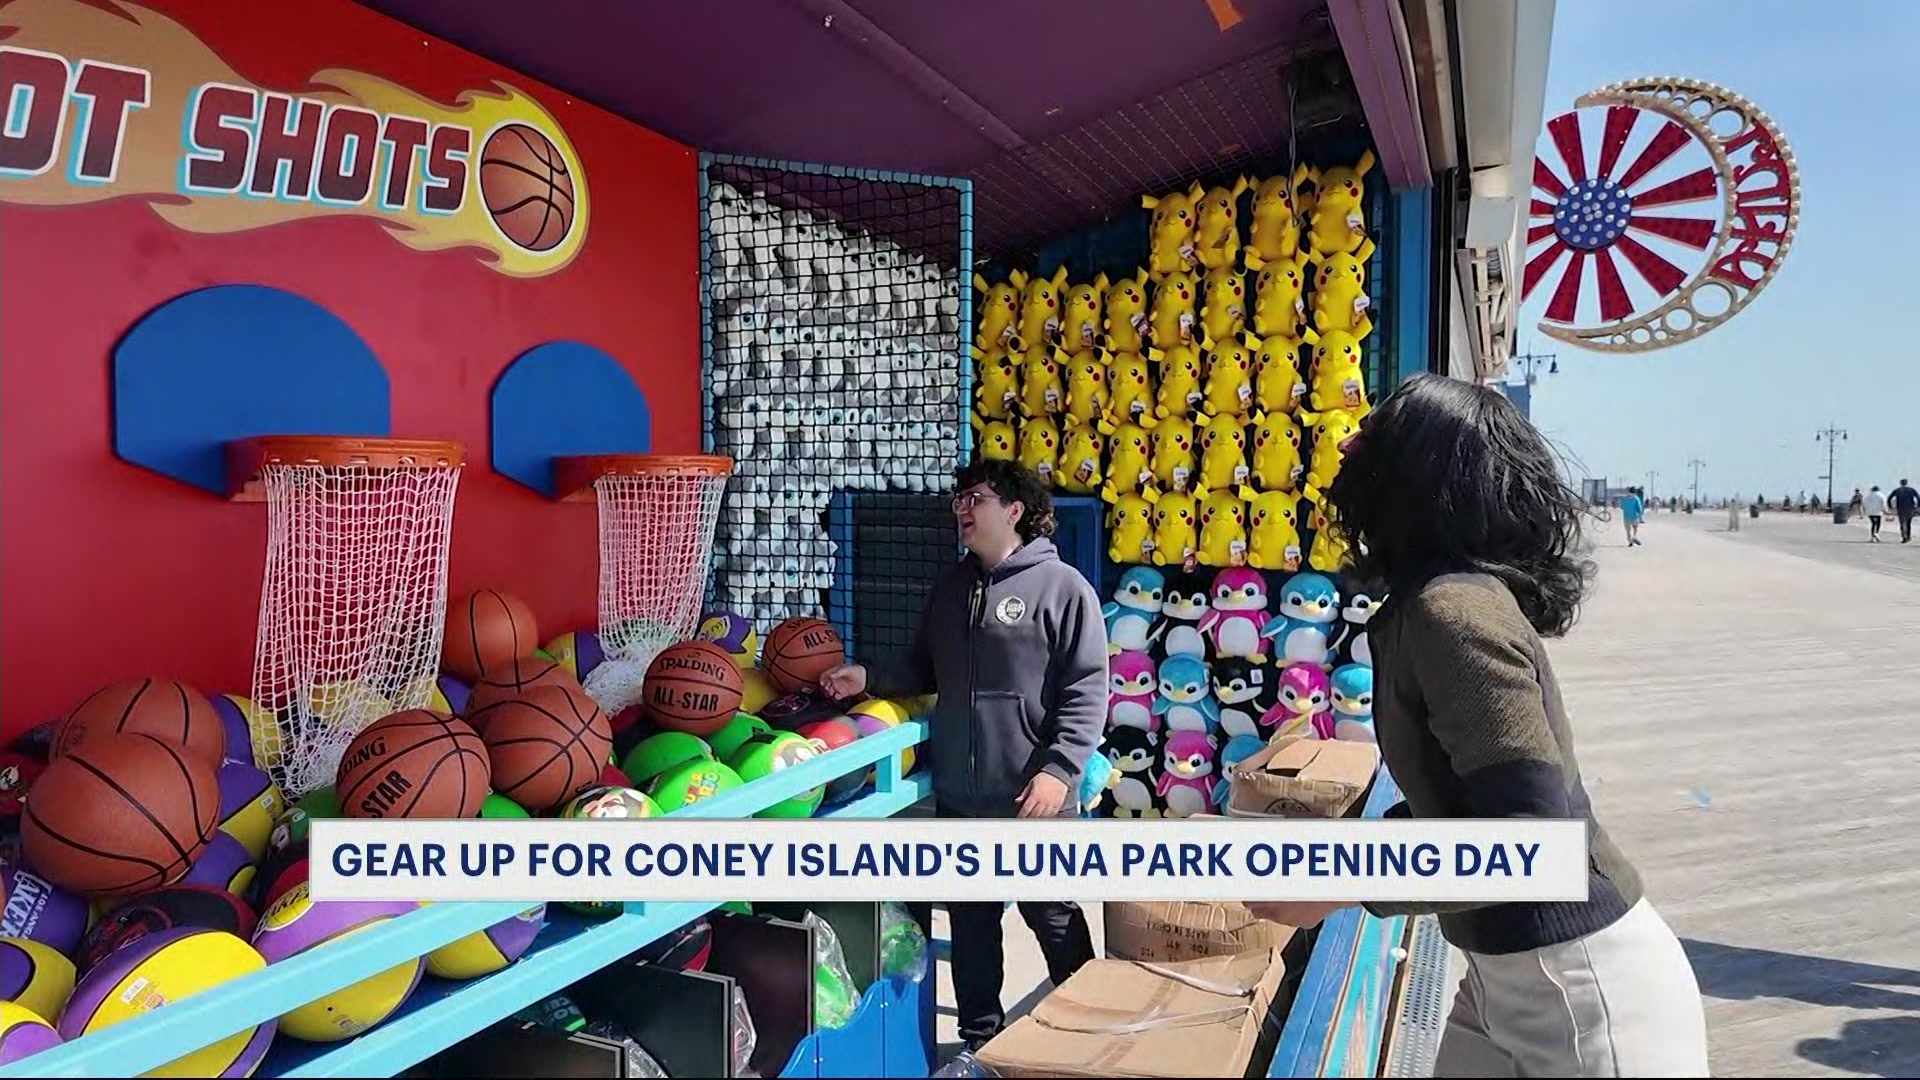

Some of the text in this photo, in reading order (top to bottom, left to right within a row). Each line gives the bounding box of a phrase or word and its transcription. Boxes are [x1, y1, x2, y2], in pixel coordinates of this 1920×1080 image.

[183, 81, 473, 215] SHOTS
[658, 657, 726, 682] SPALDING
[653, 685, 720, 712] ALL-STAR
